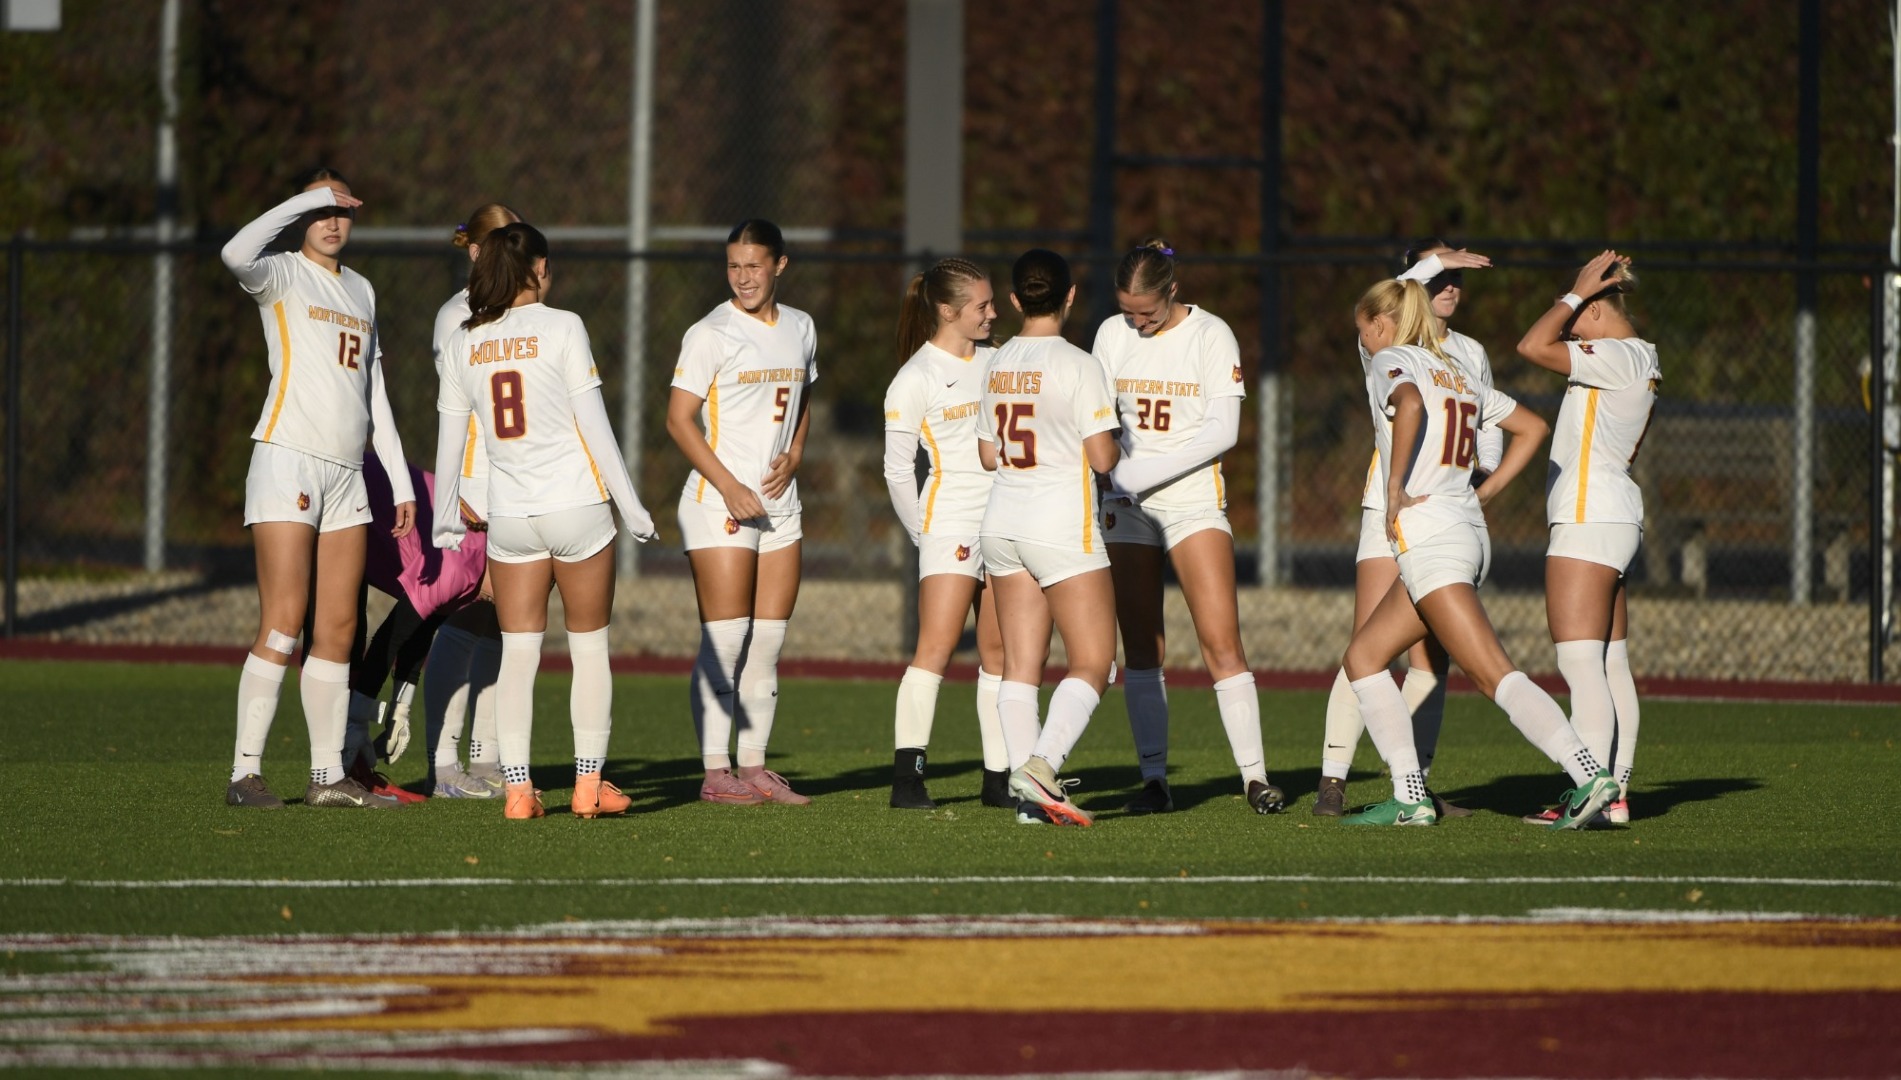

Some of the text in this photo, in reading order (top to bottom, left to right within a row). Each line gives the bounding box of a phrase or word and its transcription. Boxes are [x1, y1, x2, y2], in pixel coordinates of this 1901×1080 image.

[308, 304, 360, 331] NORTHERN
[338, 330, 361, 370] 12
[469, 336, 539, 366] WOLVES
[737, 367, 793, 384] NORTHERN
[987, 370, 1043, 394] WOLVES
[1165, 381, 1201, 397] STATE
[489, 368, 528, 441] 8
[772, 386, 791, 424] 5
[1136, 397, 1172, 432] 26
[994, 401, 1038, 470] 15
[1440, 396, 1478, 469] 16
